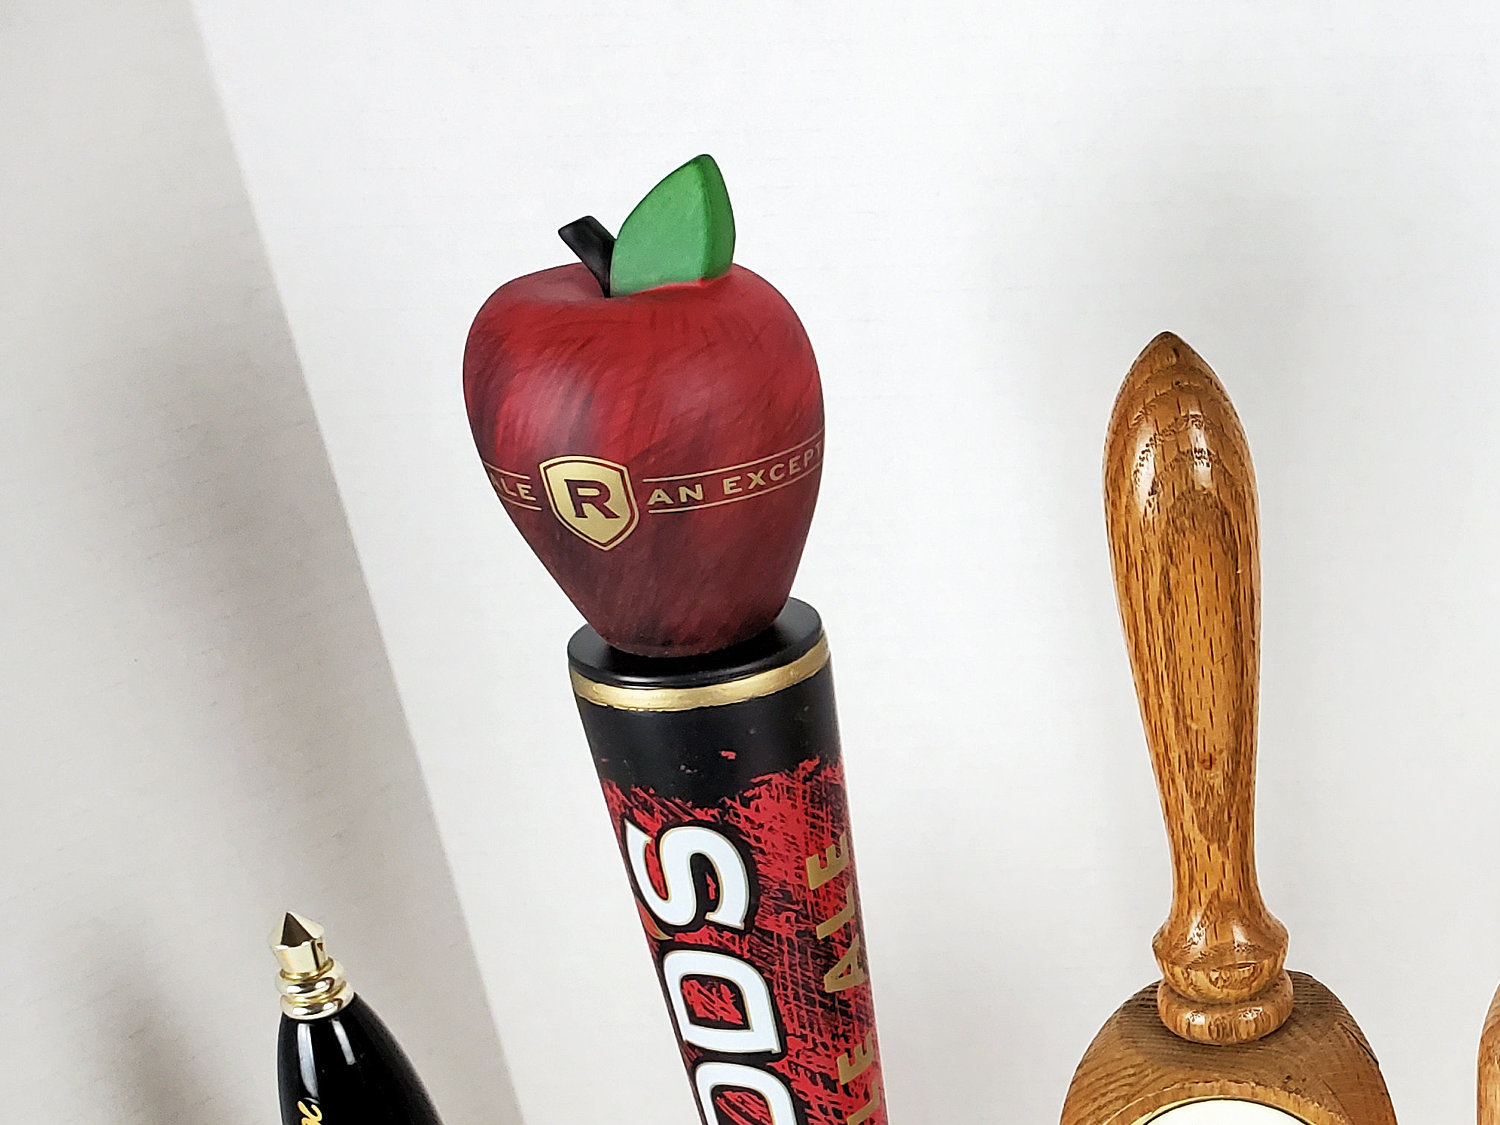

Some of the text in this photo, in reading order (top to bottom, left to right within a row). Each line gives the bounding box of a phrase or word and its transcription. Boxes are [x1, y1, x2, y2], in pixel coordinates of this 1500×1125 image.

[563, 478, 621, 519] R
[647, 483, 704, 506] AN
[805, 832, 867, 994] ALE
